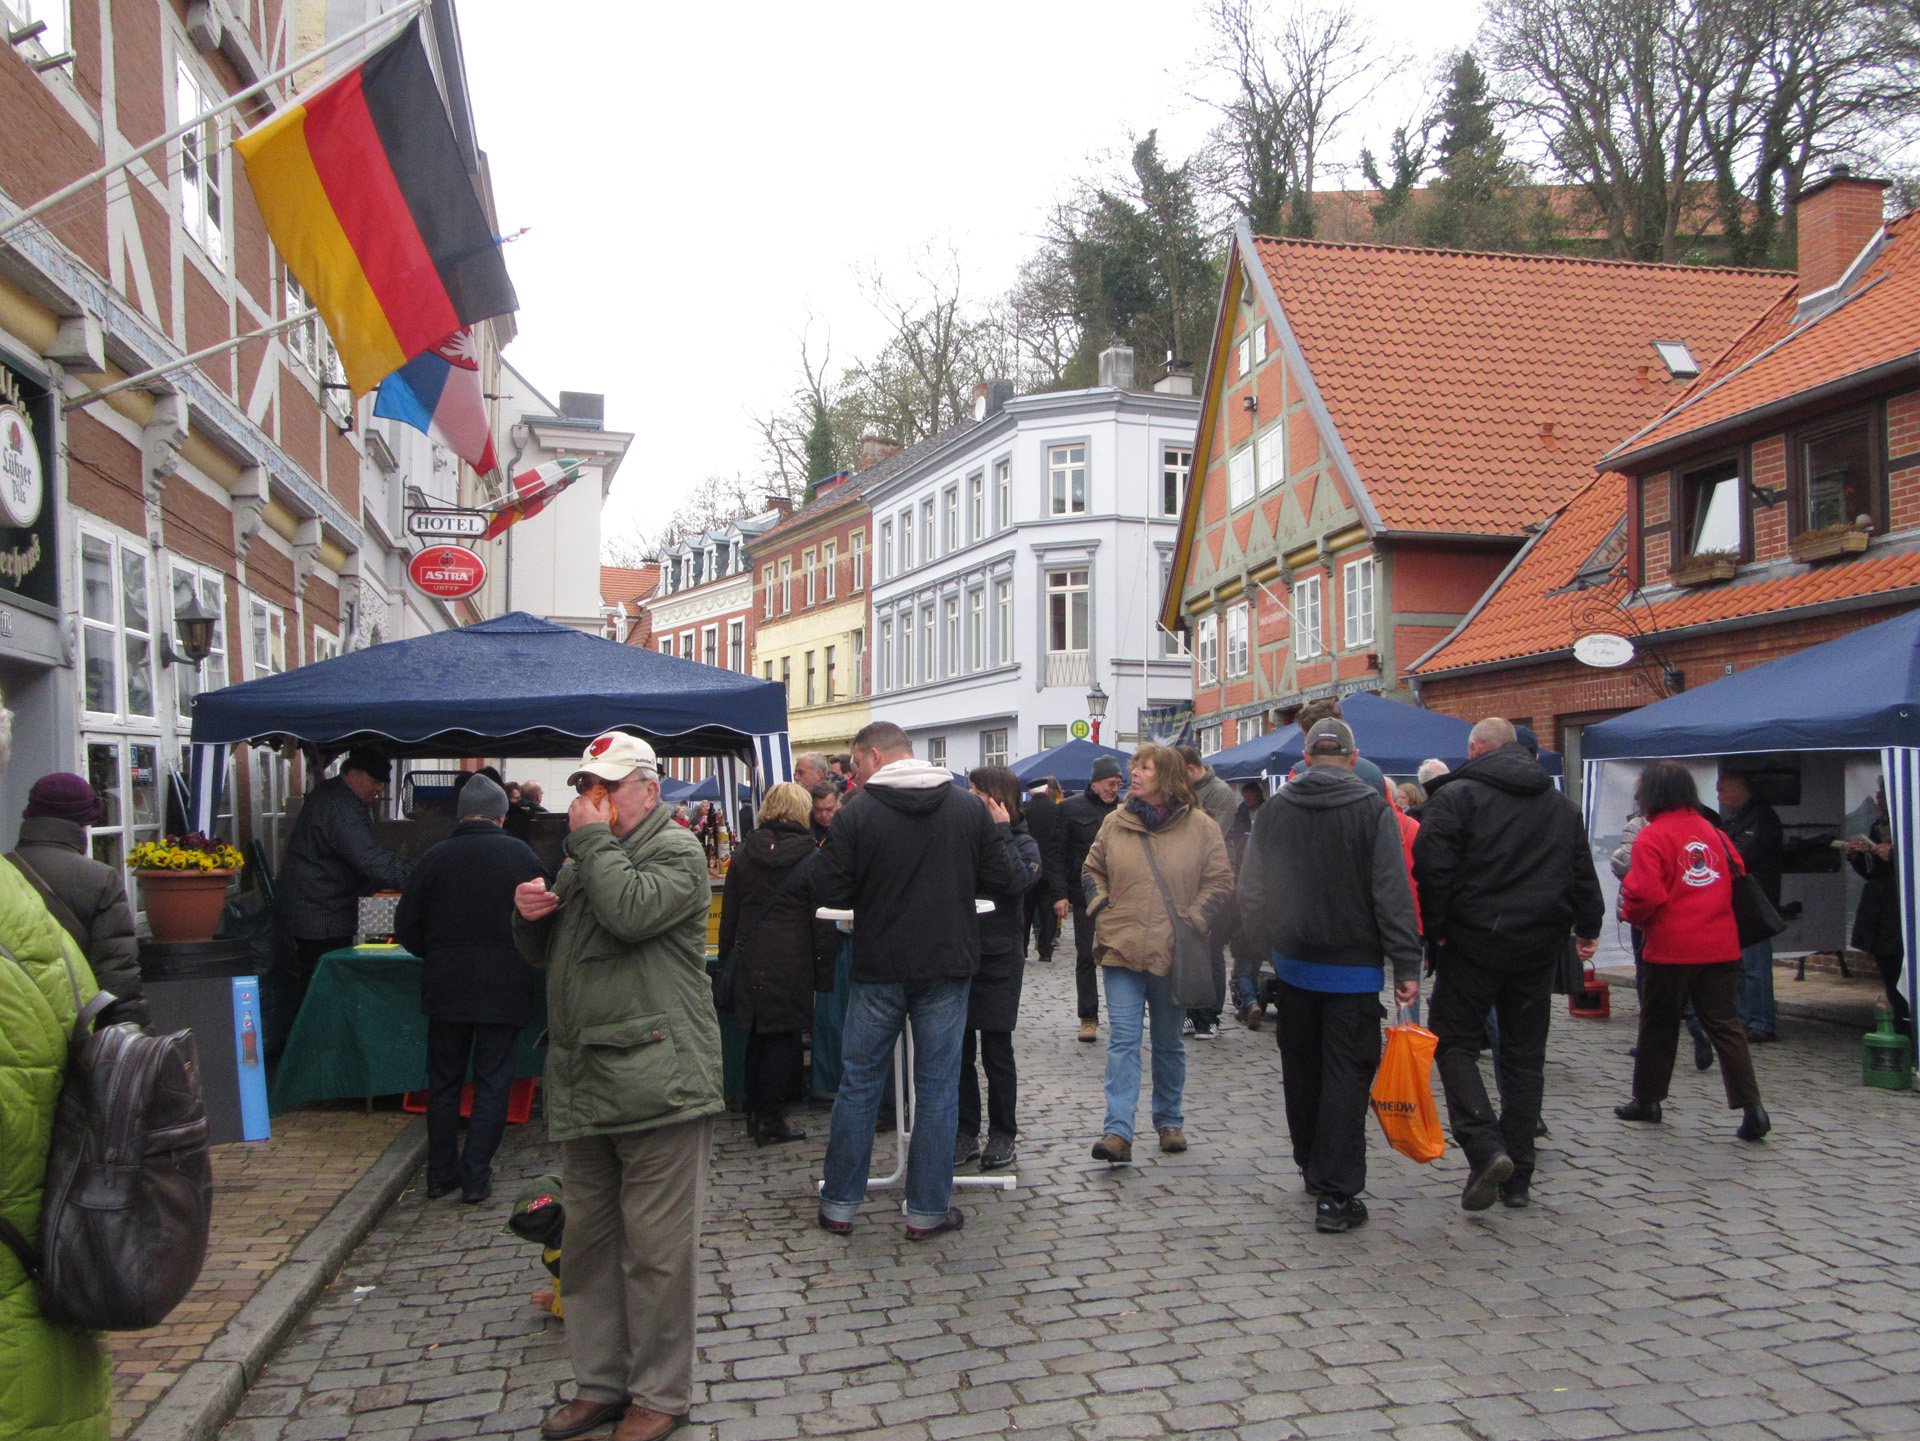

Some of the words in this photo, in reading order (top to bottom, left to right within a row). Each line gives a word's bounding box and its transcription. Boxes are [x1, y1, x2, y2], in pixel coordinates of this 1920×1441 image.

[3, 445, 32, 485] Lübzer
[12, 479, 26, 504] Pils
[417, 516, 479, 532] HOTEL
[425, 571, 469, 581] ASTRA
[1075, 723, 1085, 735] H
